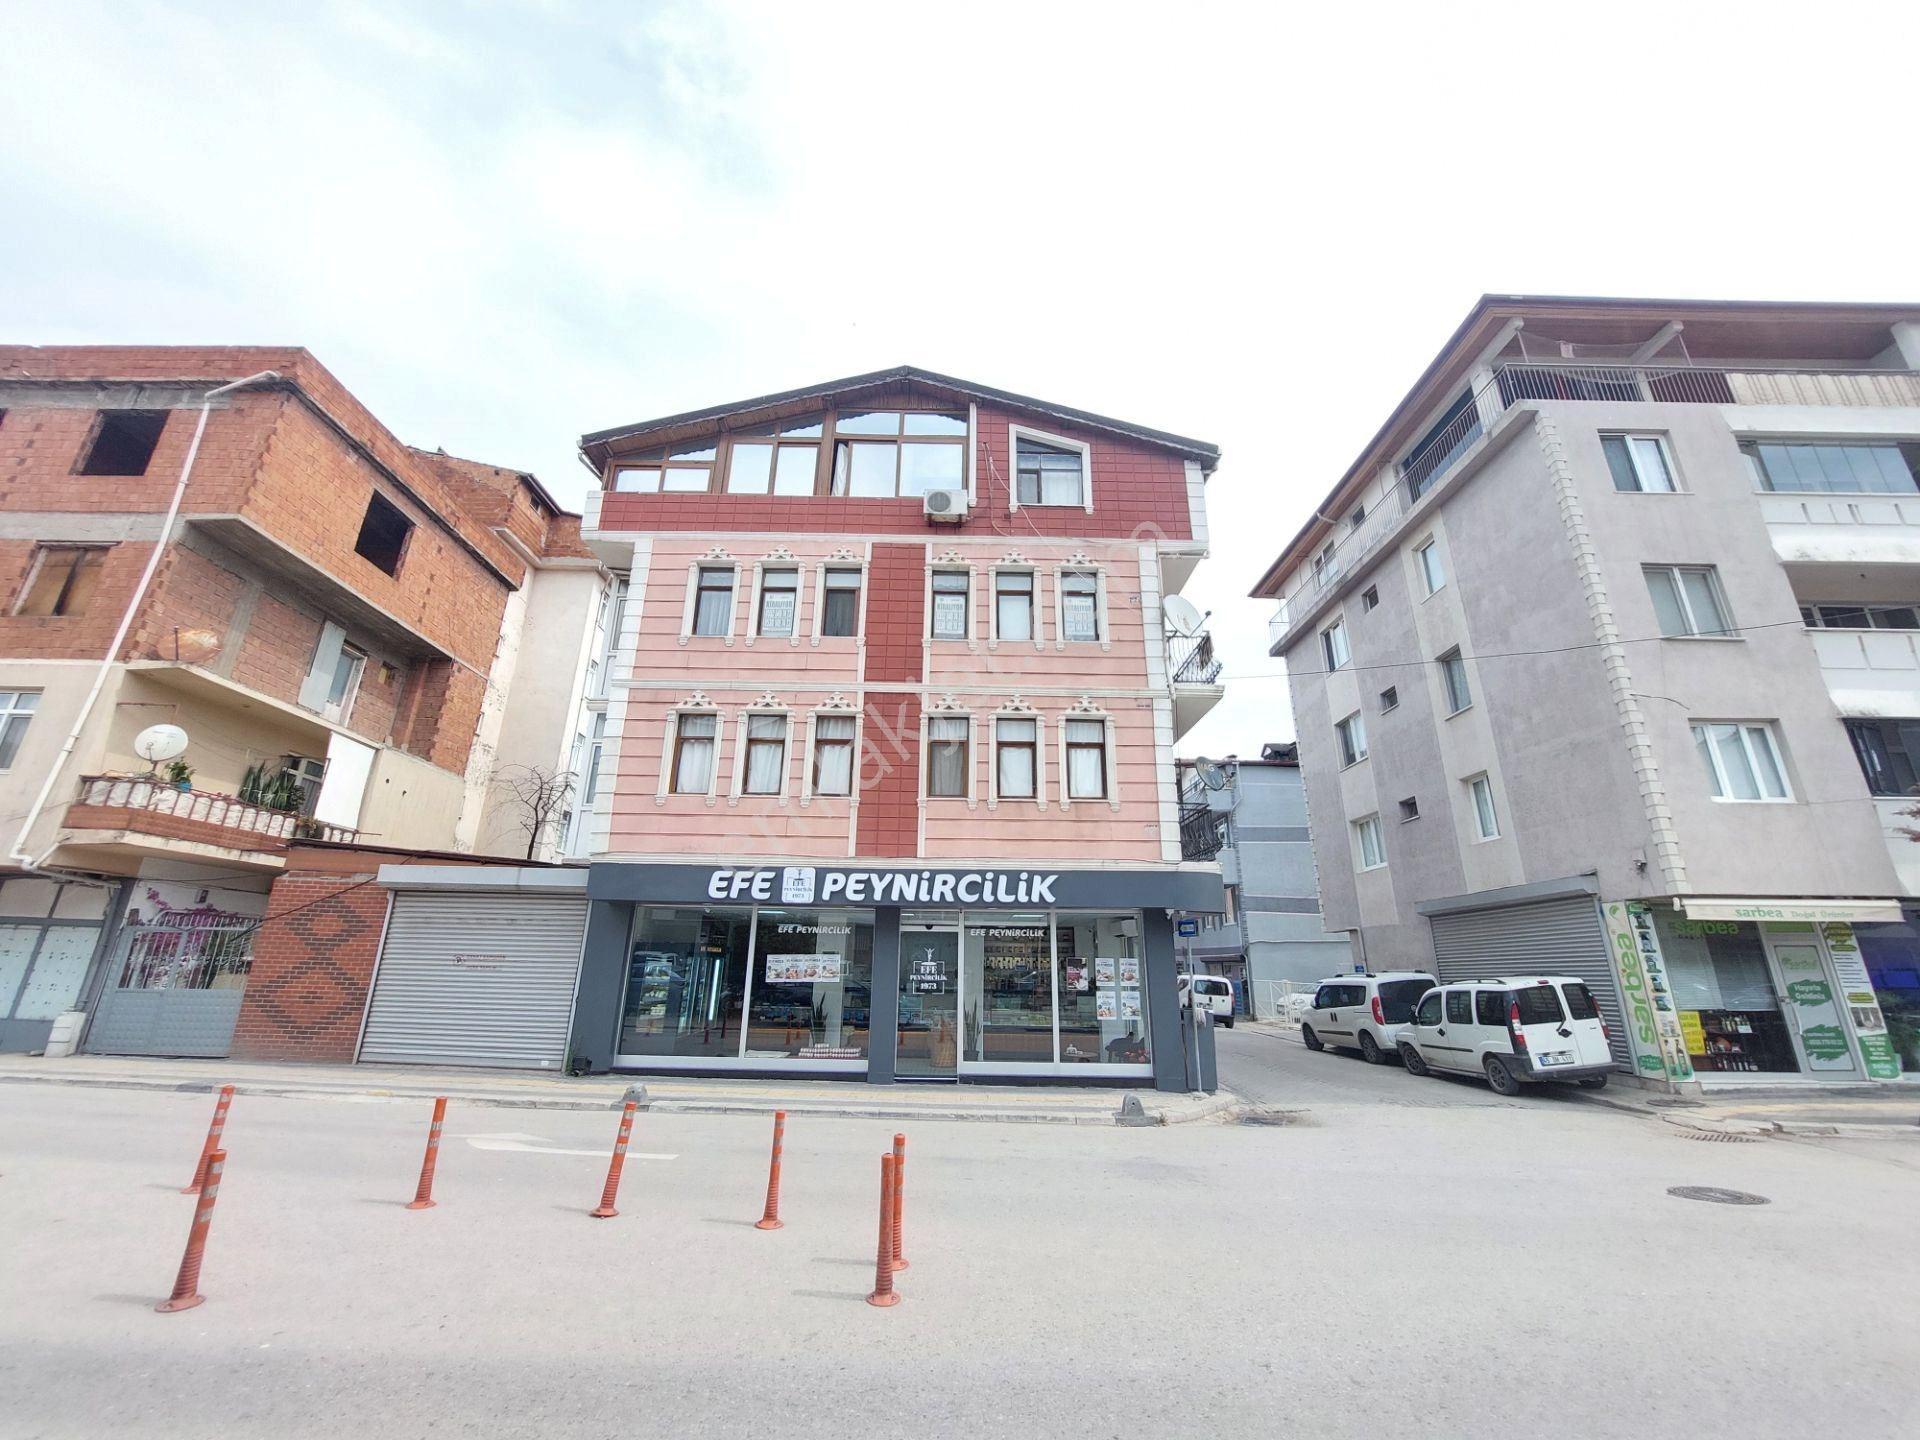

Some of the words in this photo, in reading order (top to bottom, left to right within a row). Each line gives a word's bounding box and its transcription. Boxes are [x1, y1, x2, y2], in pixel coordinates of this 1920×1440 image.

[708, 870, 776, 900] EFE
[1735, 905, 1784, 919] sarbea
[777, 924, 794, 934] EFE
[970, 928, 987, 936] EFE
[920, 965, 938, 974] EFE
[920, 982, 937, 990] 1973
[1616, 932, 1656, 1046] sarbea
